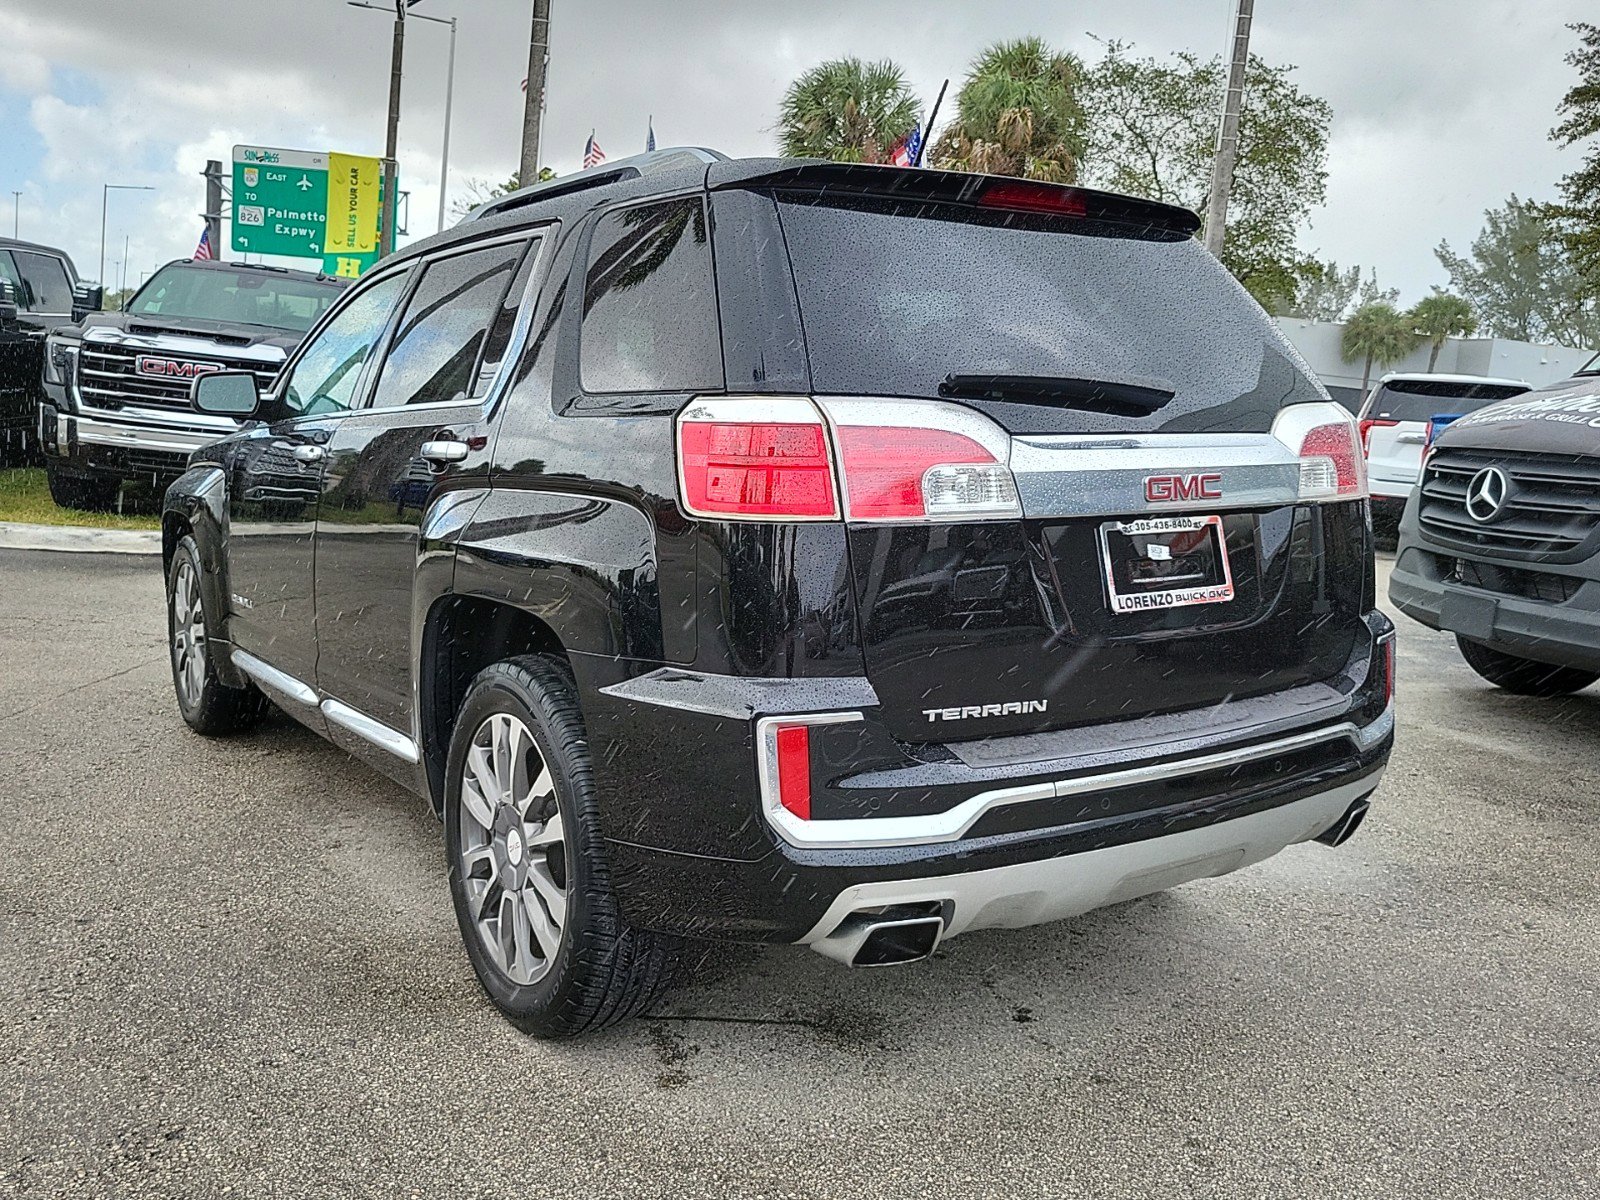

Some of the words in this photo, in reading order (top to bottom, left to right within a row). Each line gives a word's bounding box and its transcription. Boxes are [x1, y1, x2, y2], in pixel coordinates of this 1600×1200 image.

[266, 172, 287, 182] EAST
[350, 167, 359, 186] CAR
[244, 192, 257, 201] TO
[349, 188, 358, 212] YOUR
[240, 212, 260, 223] 826
[267, 208, 326, 222] Palmetto
[348, 214, 357, 226] US
[275, 223, 316, 239] Expwy
[347, 227, 356, 248] SELL
[1144, 473, 1222, 502] GMC
[1118, 593, 1174, 610] LORENZO
[1175, 588, 1207, 602] BUICK
[1208, 588, 1231, 599] GMC
[922, 699, 1048, 723] TERRAIN
